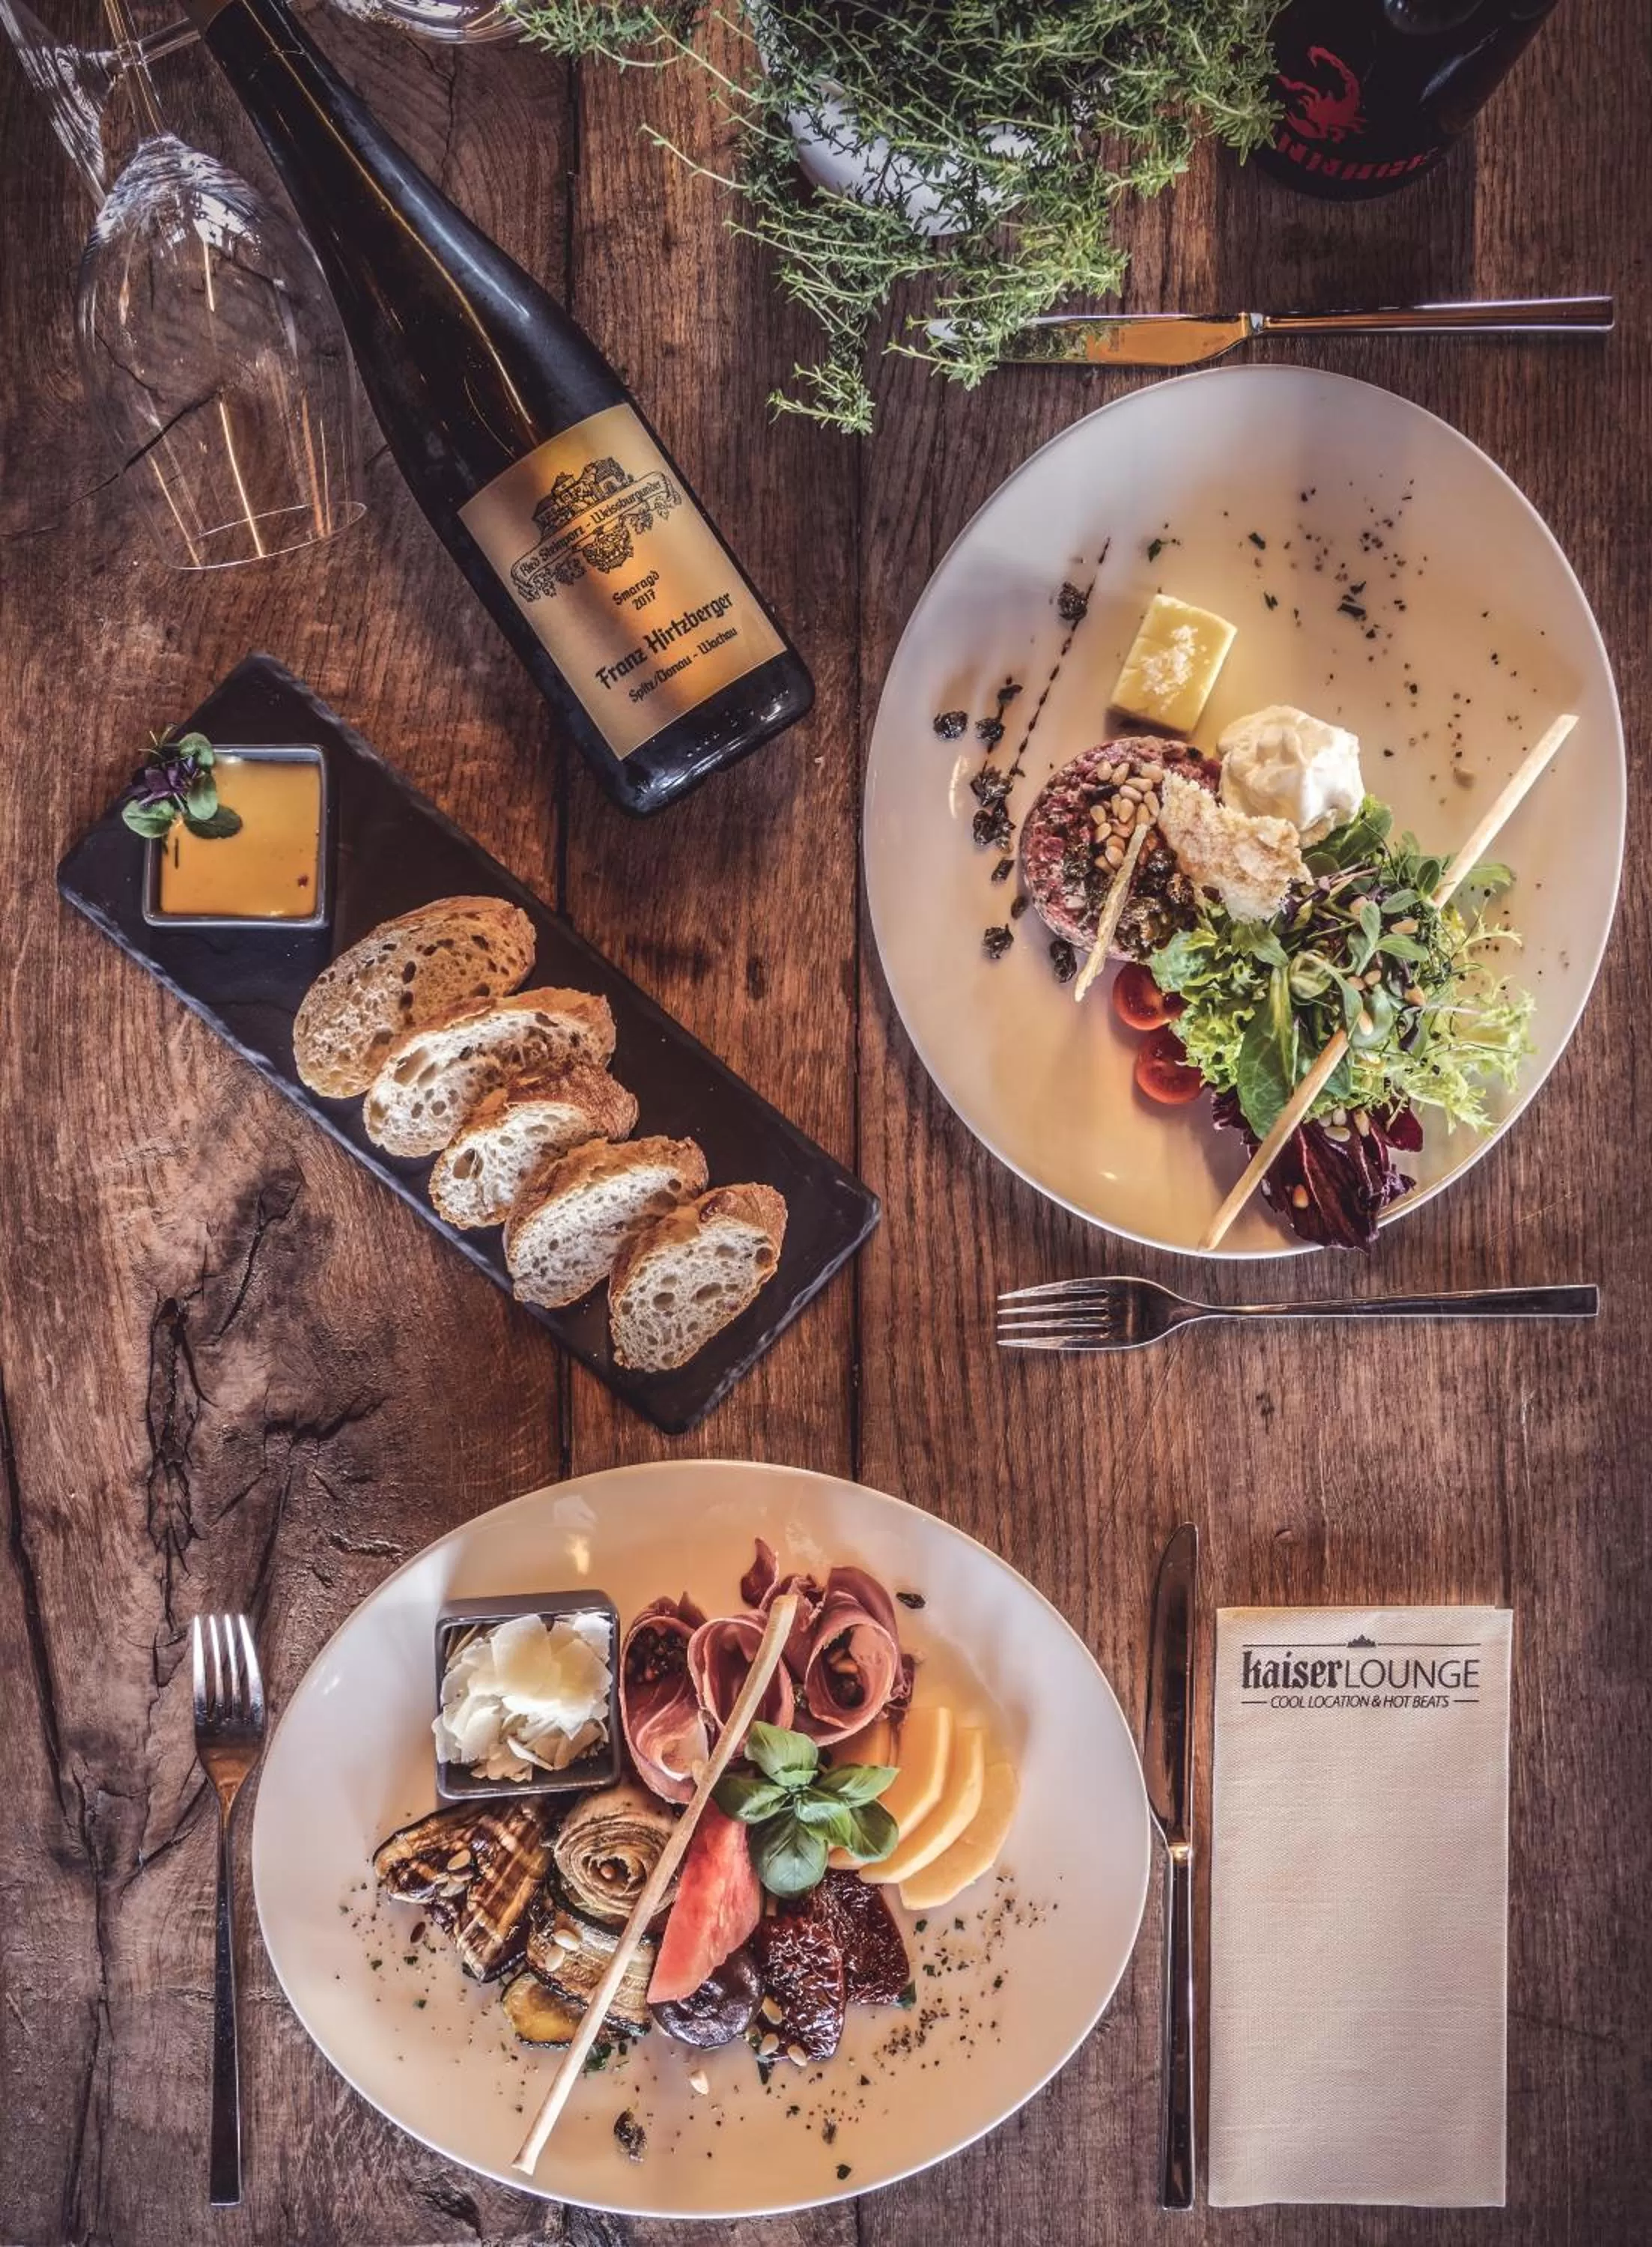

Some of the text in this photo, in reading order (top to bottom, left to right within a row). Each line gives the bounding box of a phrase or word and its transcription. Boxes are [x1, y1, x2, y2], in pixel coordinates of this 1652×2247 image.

[591, 480, 662, 524] Weissburgunder
[613, 570, 660, 606] Smaragd
[632, 589, 656, 610] 2017
[595, 592, 734, 691] Franz Hirtzberger
[697, 628, 738, 655] Wachau
[1271, 1695, 1306, 1709] COOL
[1308, 1694, 1370, 1709] LOCATION
[1382, 1695, 1411, 1708] HOT
[1412, 1695, 1450, 1708] BEATS
